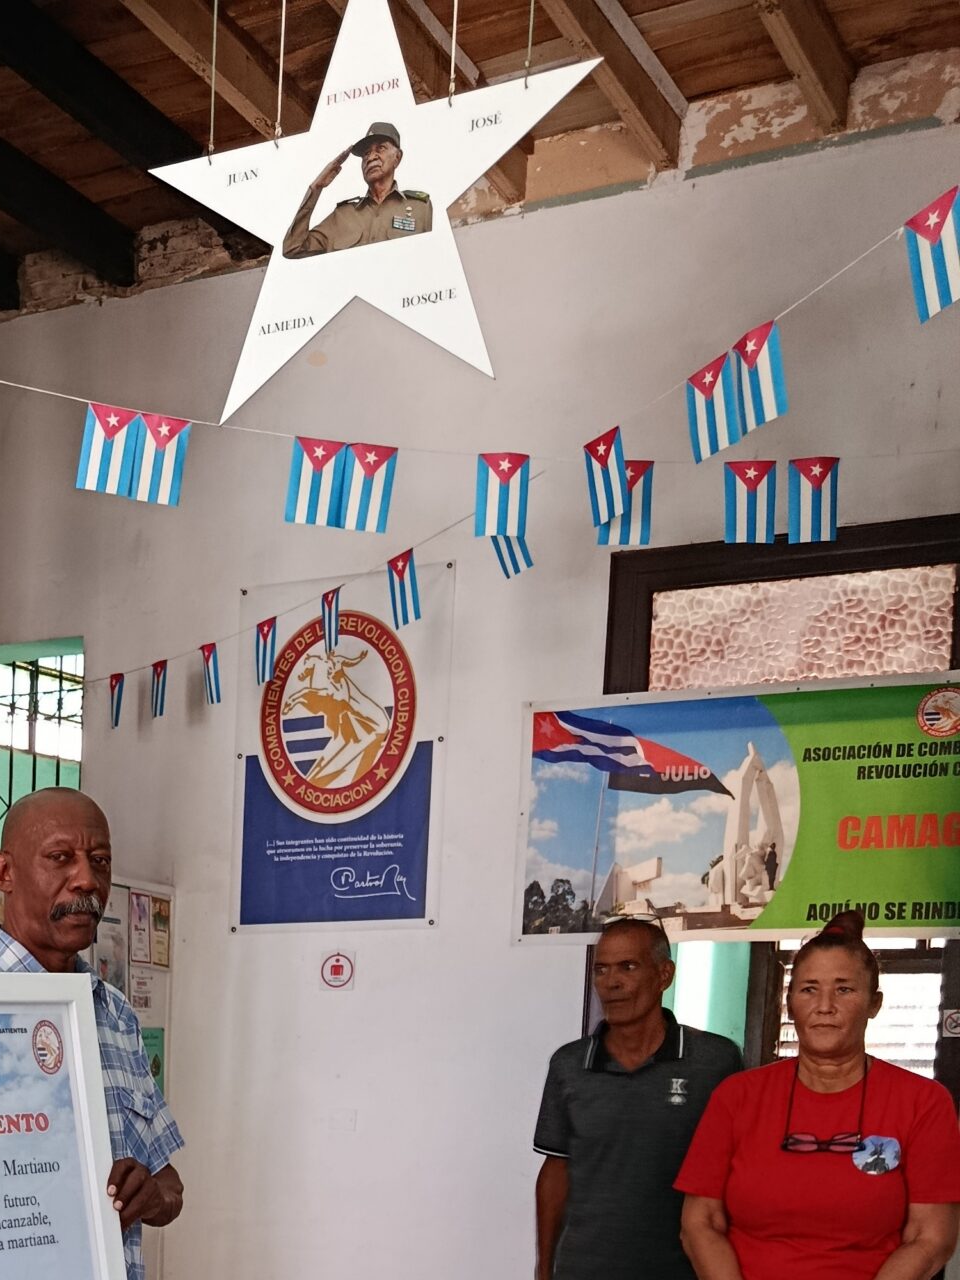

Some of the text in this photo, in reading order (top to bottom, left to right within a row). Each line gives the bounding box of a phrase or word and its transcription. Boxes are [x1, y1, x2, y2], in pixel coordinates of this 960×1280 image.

[326, 77, 400, 106] FUNDADOR
[468, 111, 502, 133] JOSÉ
[226, 168, 258, 186] JUAN
[401, 288, 457, 309] BOSQUE
[258, 316, 315, 336] ALMEIDA
[265, 650, 296, 770] COMBATIENTES
[295, 628, 315, 651] DE
[339, 616, 408, 685] REVOLUCION
[387, 688, 410, 756] CUBANA
[802, 742, 892, 762] ASOCIACIÓN
[896, 743, 914, 758] DE
[660, 765, 711, 782] JULIO
[857, 760, 949, 780] REVOLUCIÓN
[296, 780, 373, 808] ASOCIACION
[884, 902, 907, 920] SE
[911, 902, 960, 920] RIND
[2, 1158, 60, 1177] Martiano
[3, 1193, 40, 1209] futuro,
[7, 1234, 60, 1250] martiana.
